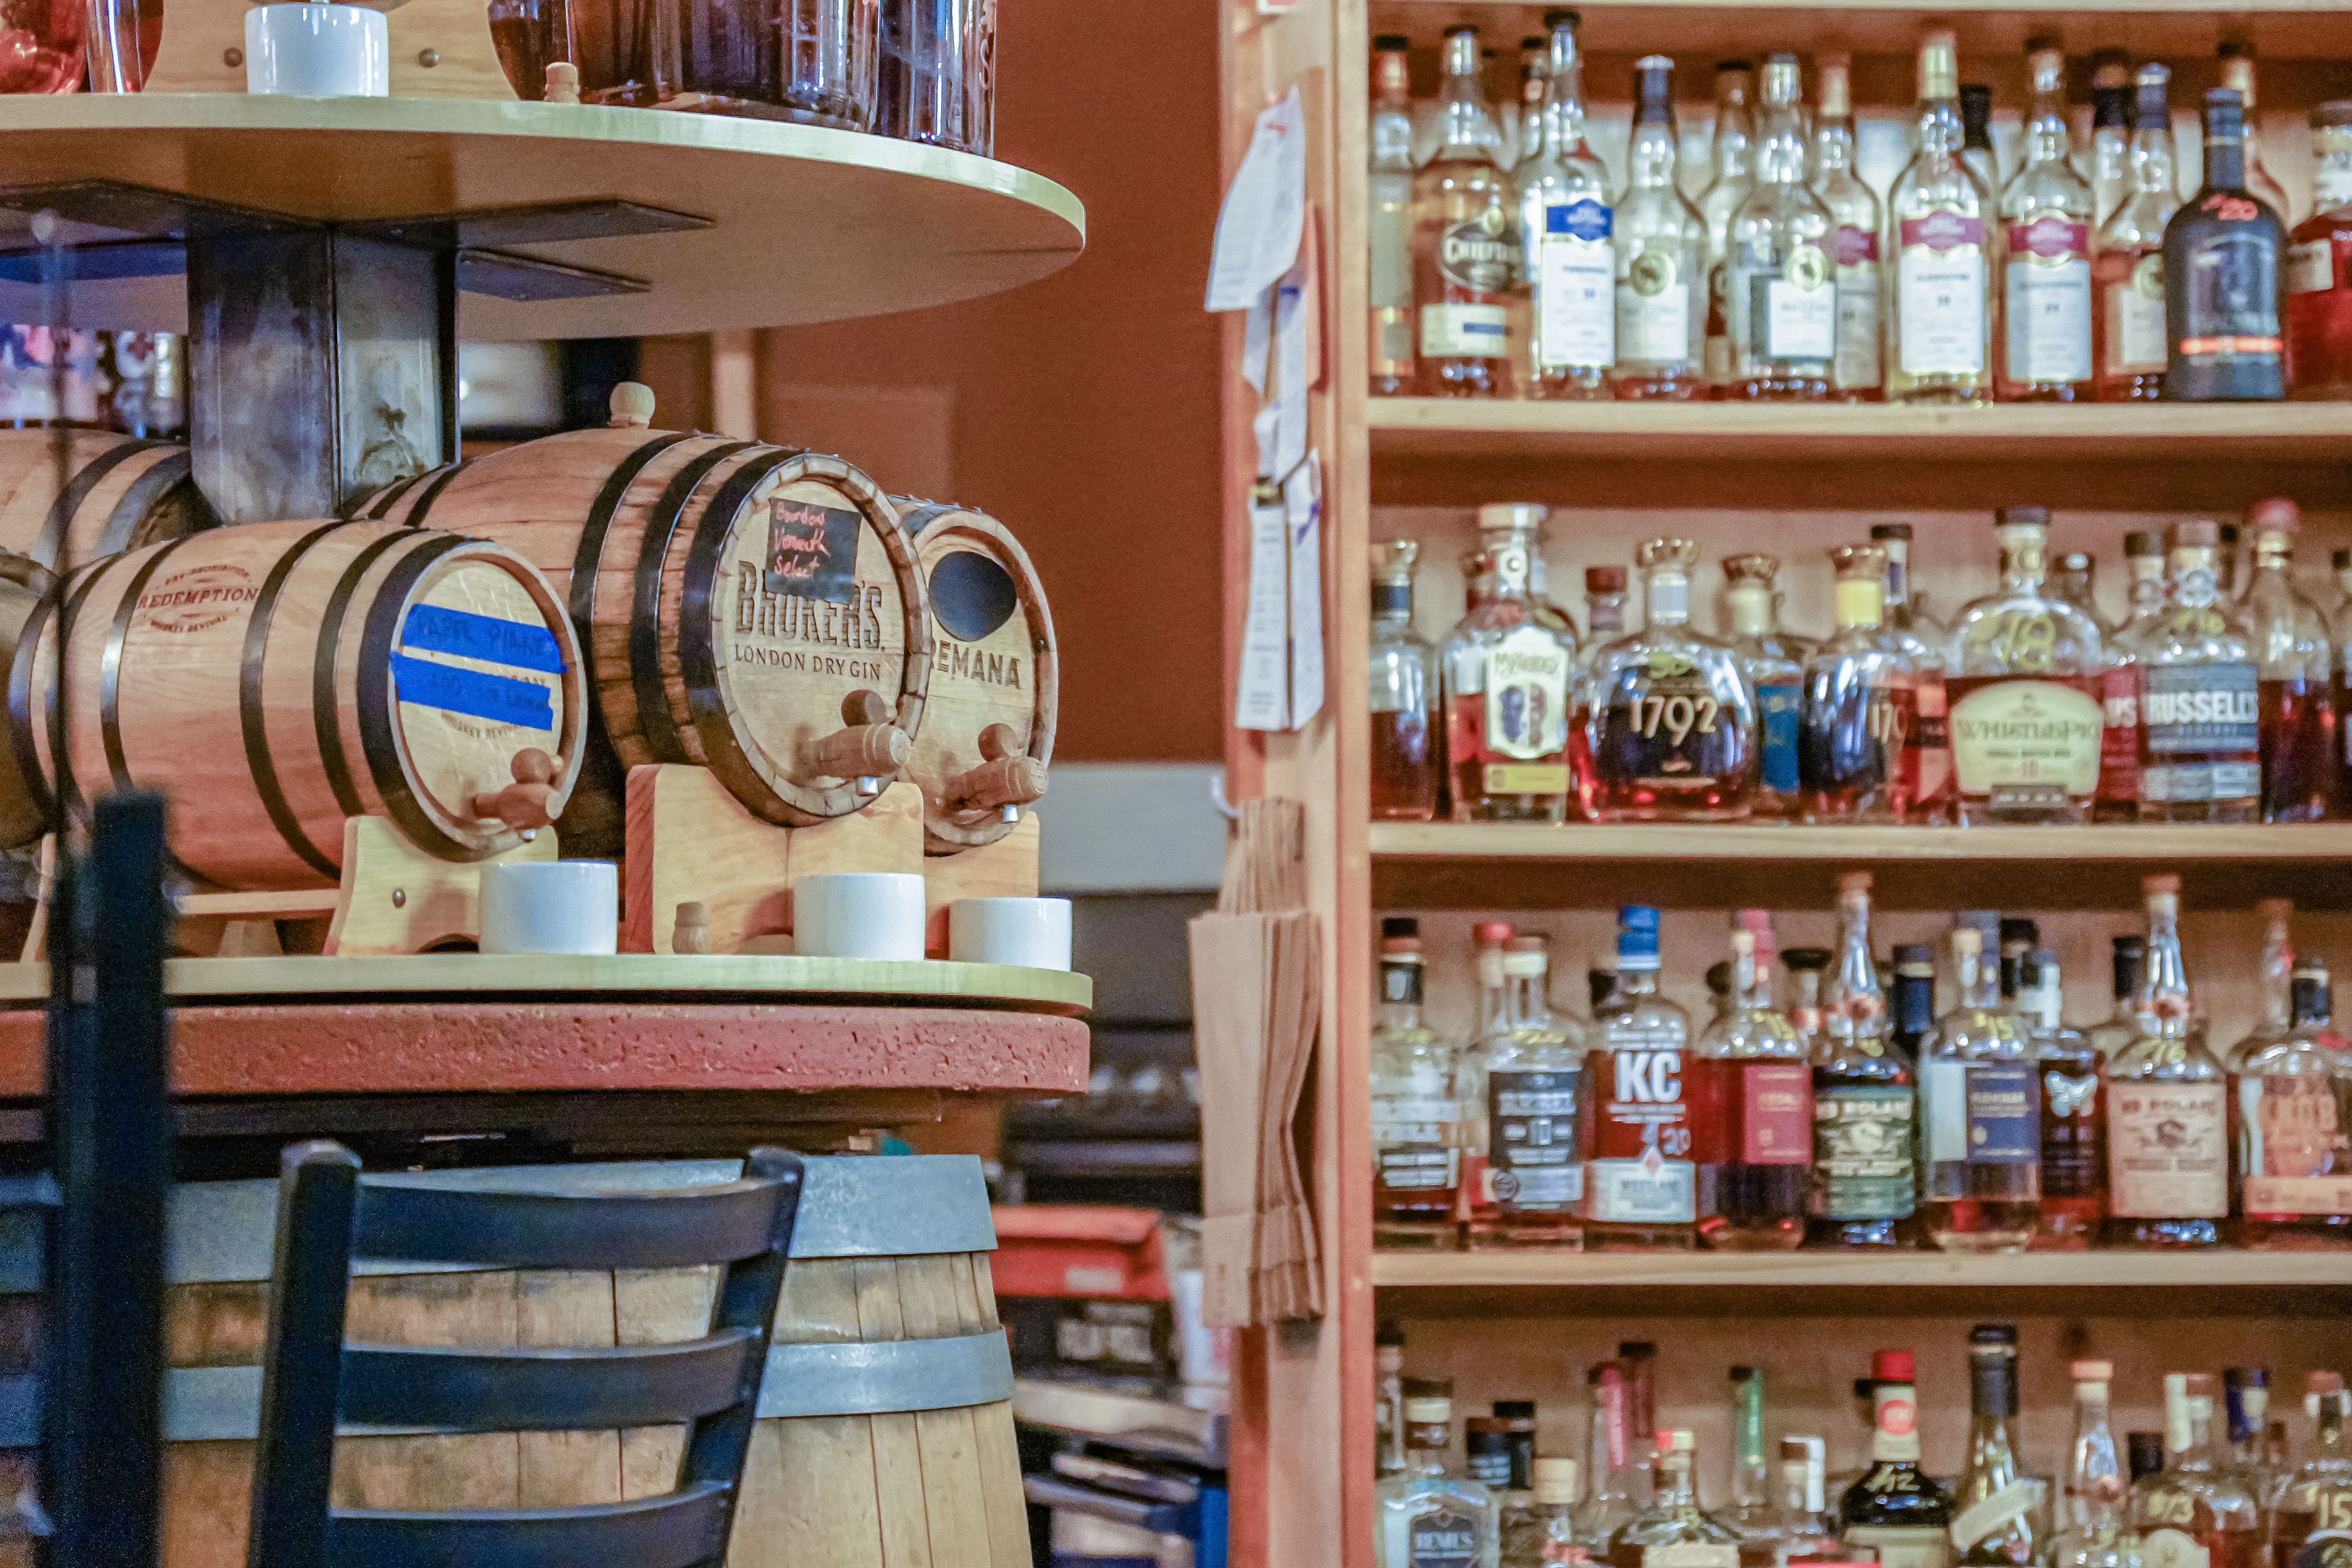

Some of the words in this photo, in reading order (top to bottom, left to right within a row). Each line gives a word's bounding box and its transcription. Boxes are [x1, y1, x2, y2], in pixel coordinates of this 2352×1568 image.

[138, 587, 259, 609] REDEMPTION
[735, 644, 805, 671] LONDON
[813, 656, 845, 676] DRY
[850, 661, 881, 681] GIN
[930, 639, 1021, 689] EMANA
[1630, 696, 1718, 747] 1792
[1616, 1051, 1682, 1102] KC
